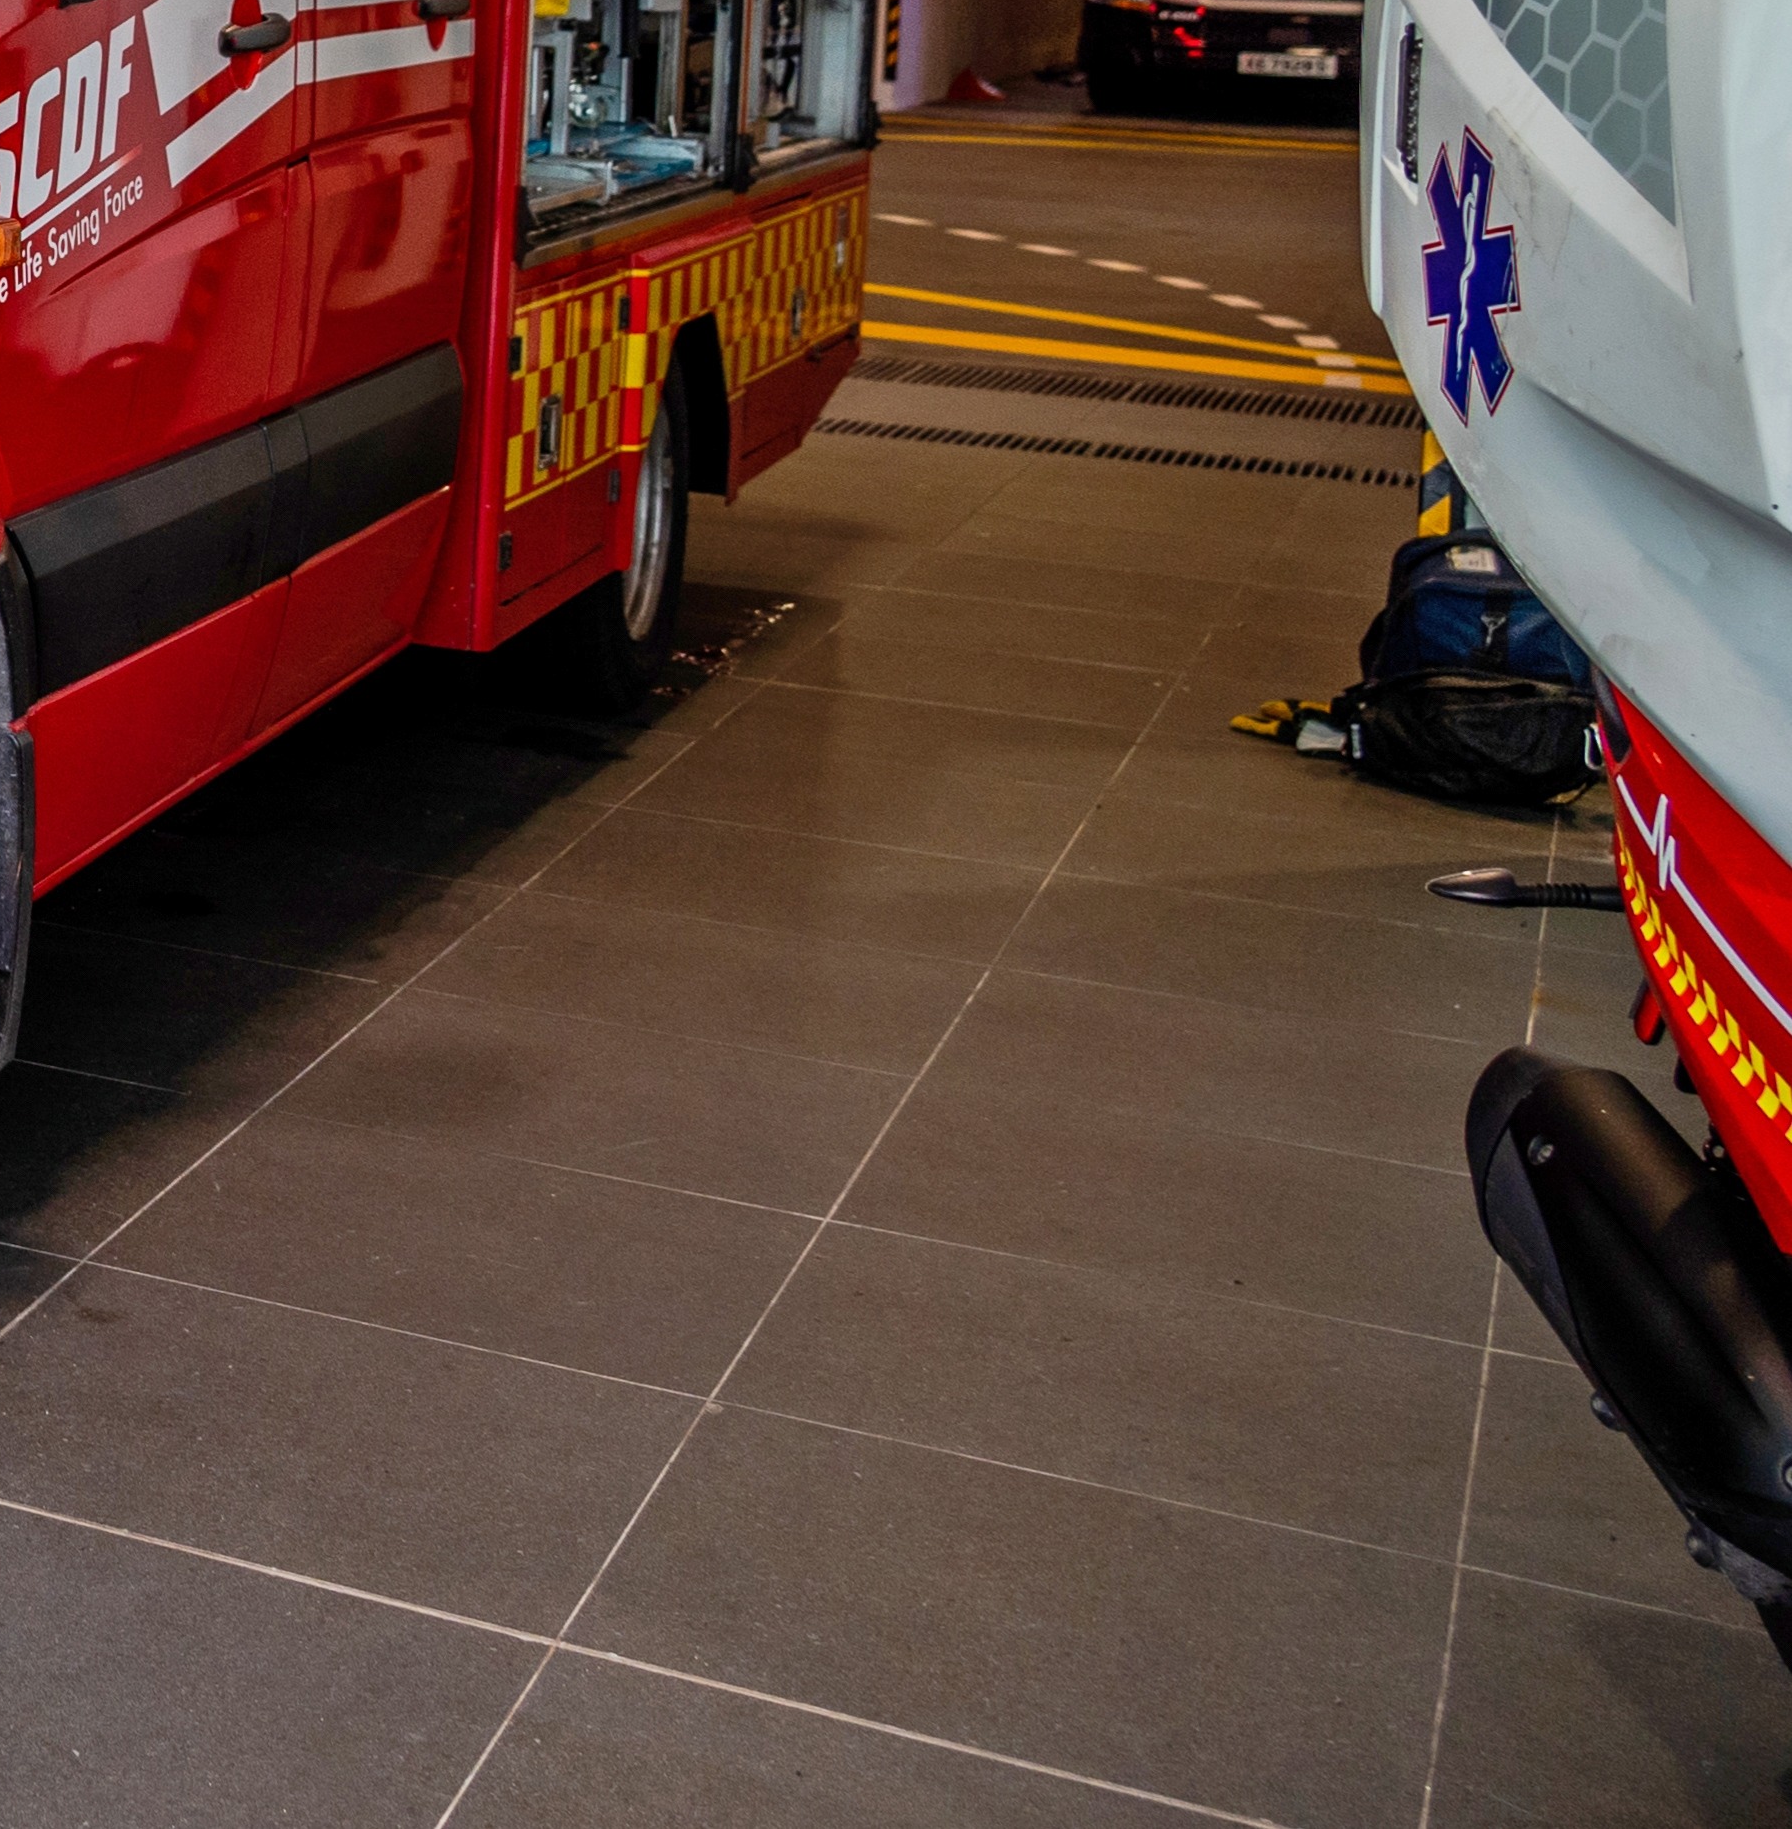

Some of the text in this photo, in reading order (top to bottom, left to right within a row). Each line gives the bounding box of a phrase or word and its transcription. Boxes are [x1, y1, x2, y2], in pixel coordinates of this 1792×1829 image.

[14, 240, 44, 293] Life
[47, 209, 101, 267] Saving
[103, 174, 144, 225] Force
